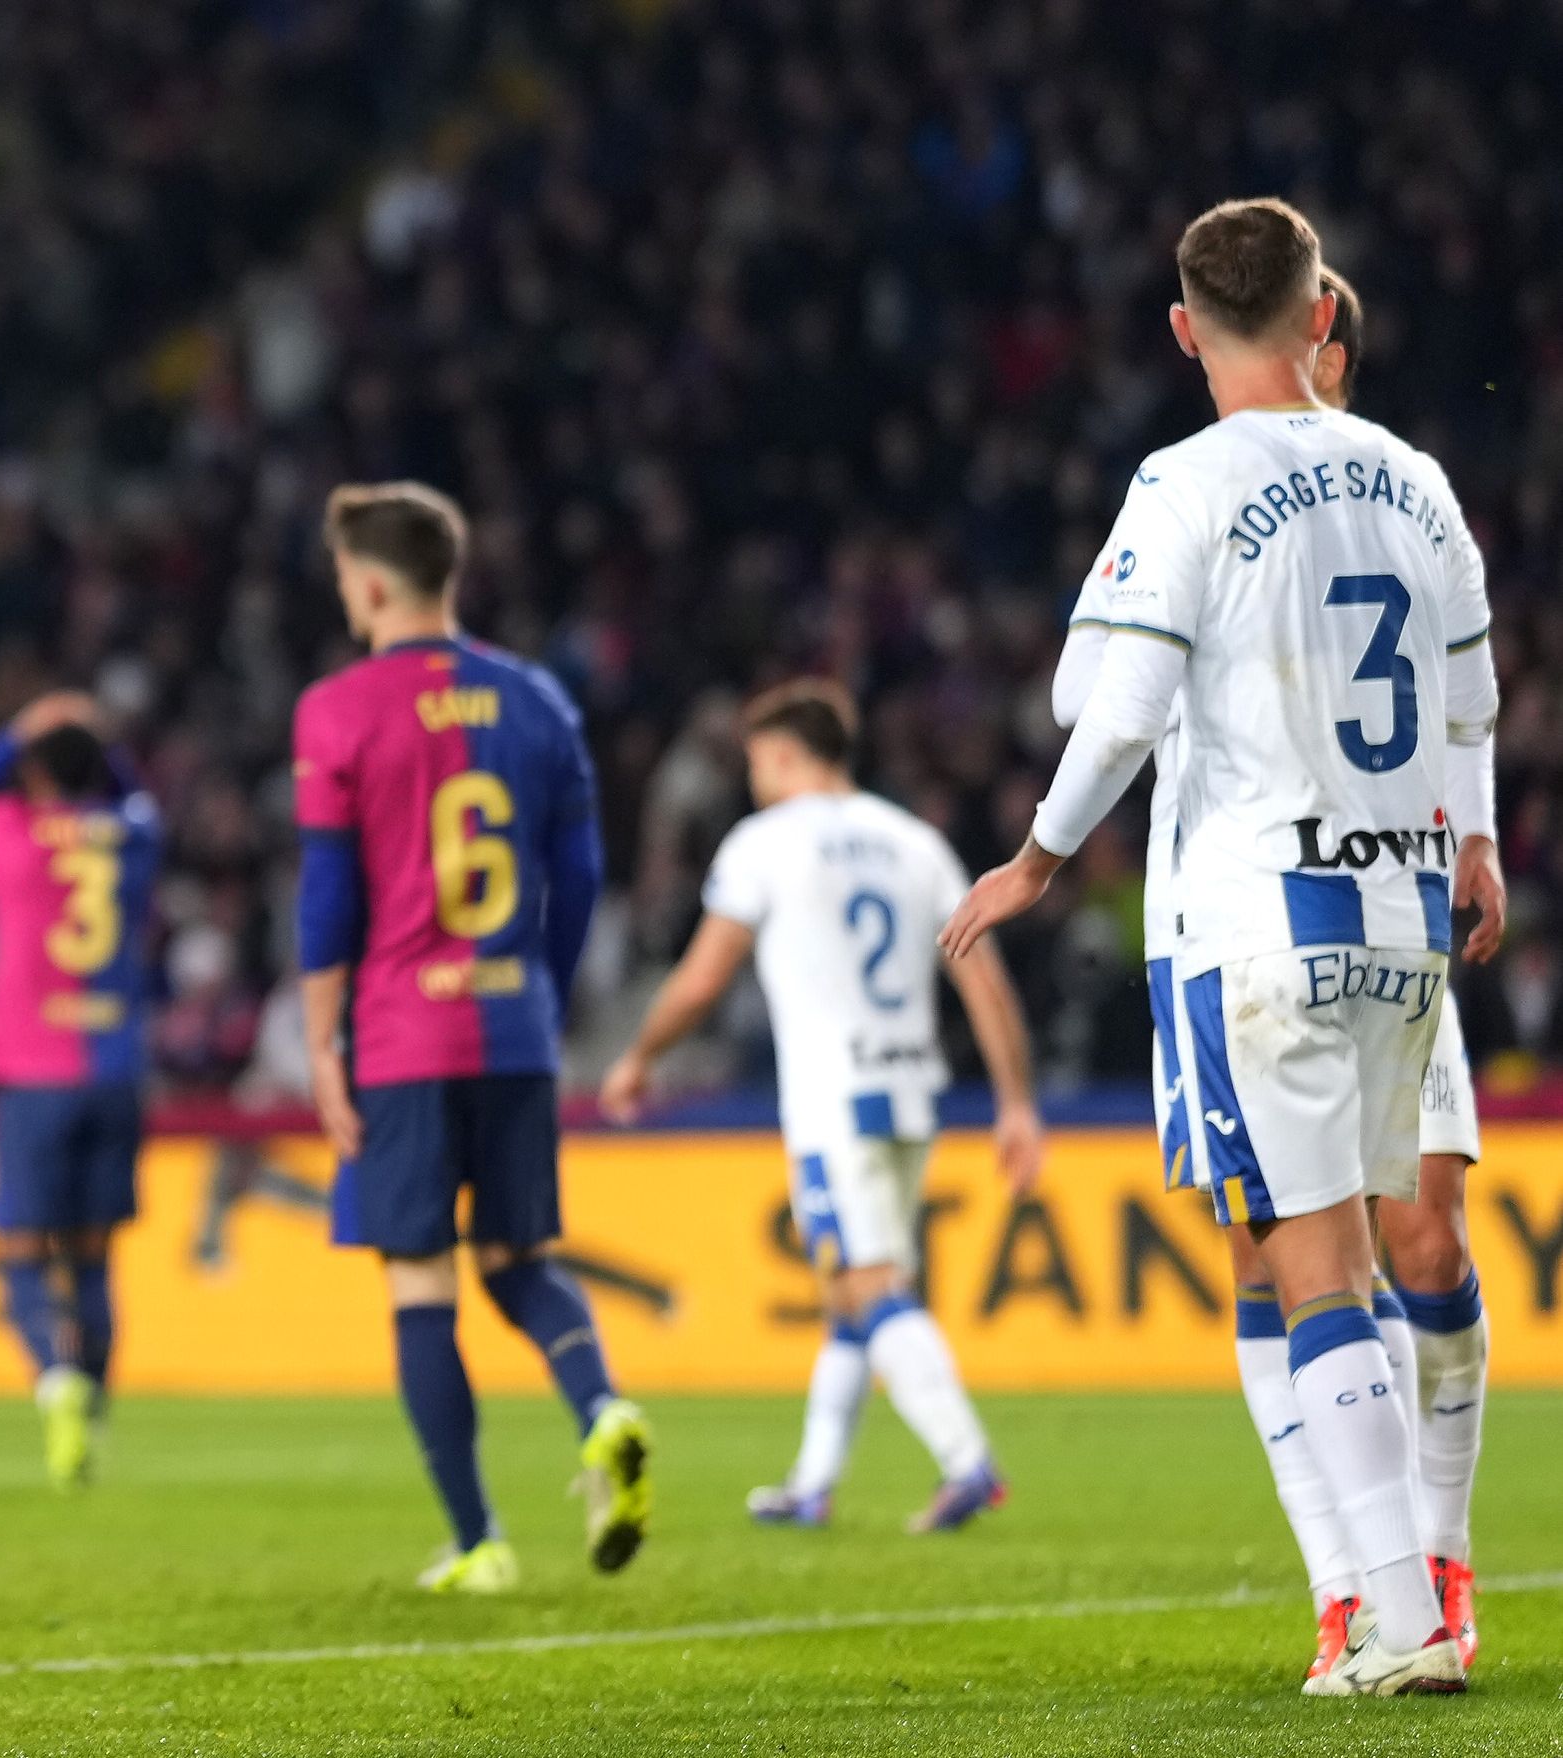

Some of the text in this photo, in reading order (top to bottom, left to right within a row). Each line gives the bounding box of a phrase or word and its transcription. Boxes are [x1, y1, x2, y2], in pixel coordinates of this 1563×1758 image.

[1226, 462, 1340, 562] JORGE
[1322, 573, 1419, 775] 3
[431, 768, 519, 942] 6
[1290, 806, 1448, 868] Lowi
[40, 844, 124, 979] 3
[844, 886, 907, 1010] 2
[1301, 951, 1441, 1022] Ebury
[768, 1192, 1563, 1320] STANY
